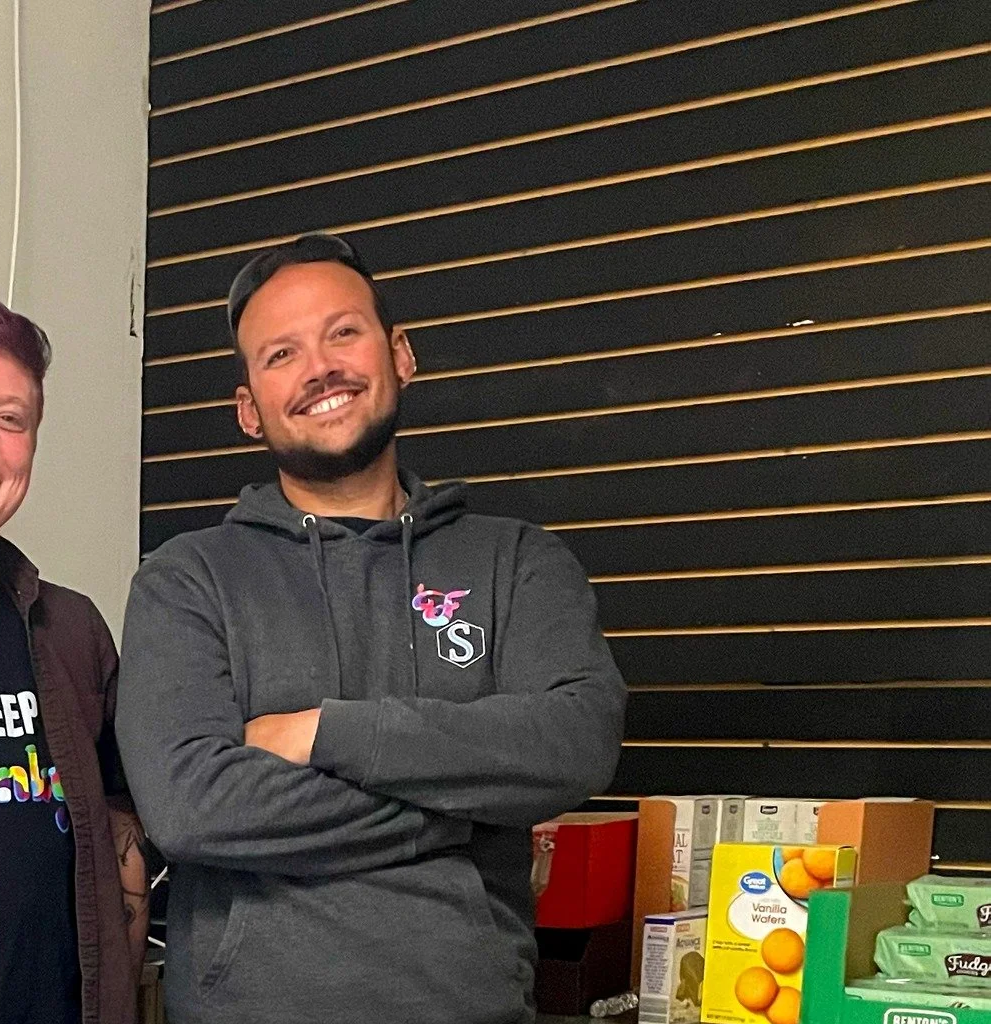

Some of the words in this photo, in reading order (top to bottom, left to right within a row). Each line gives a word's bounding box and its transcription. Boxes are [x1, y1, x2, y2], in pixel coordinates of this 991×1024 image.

[447, 623, 474, 662] S
[742, 875, 767, 885] Great
[752, 902, 787, 914] Vanilla
[751, 913, 787, 925] Wafers
[947, 955, 991, 976] Fudg
